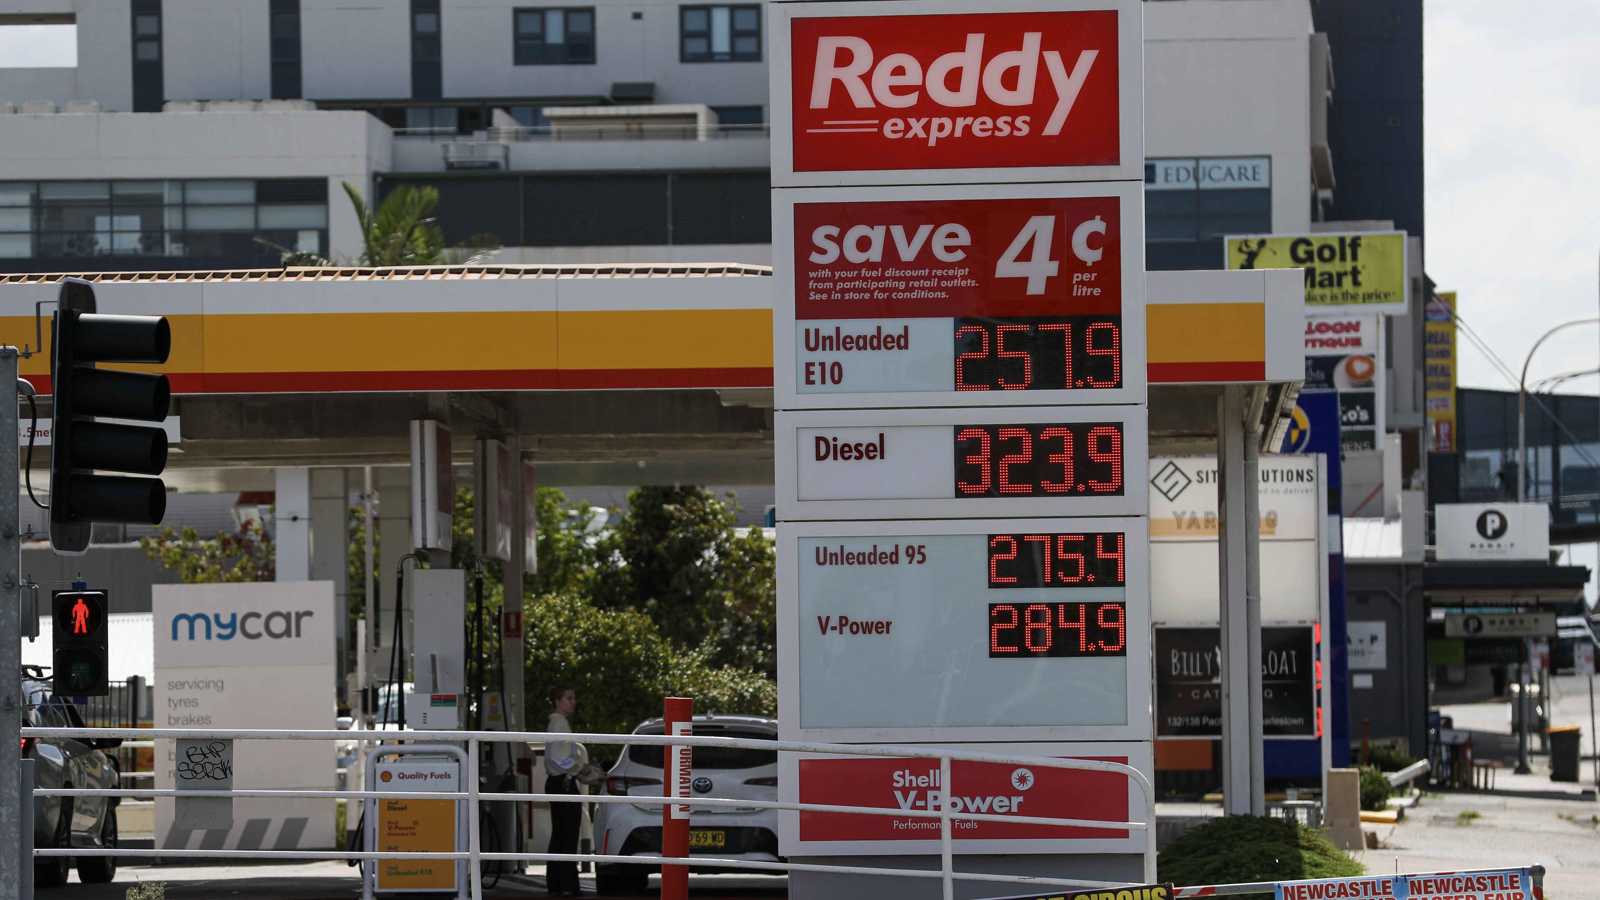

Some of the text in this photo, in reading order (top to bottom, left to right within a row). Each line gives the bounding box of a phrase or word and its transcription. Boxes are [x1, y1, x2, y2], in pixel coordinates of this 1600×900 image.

[809, 31, 1100, 136] Reddy
[882, 114, 1031, 147] express
[1163, 164, 1262, 184] EDUCARE
[809, 222, 972, 265] save
[994, 215, 1060, 296] 4
[1289, 235, 1362, 264] Golf
[808, 266, 969, 280] with your fuel discount receipt
[1073, 270, 1097, 286] per
[808, 277, 979, 291] from participating retail outlets.
[1072, 284, 1102, 296] litre
[808, 288, 949, 301] See in store for conditions.
[804, 325, 910, 351] Unleaded
[955, 322, 1121, 392] 257.9
[804, 361, 843, 385] E10
[814, 432, 886, 461] Diesel
[957, 425, 1122, 494] 323.9
[1196, 470, 1219, 484] SIT
[815, 544, 927, 566] Unleaded 95
[990, 534, 1124, 583] 275.4
[171, 609, 314, 641] mycar
[817, 615, 893, 635] V-Power
[990, 603, 1127, 653] 284.9
[1171, 648, 1297, 677] BILLY OAT
[168, 679, 224, 693] servicing
[168, 696, 199, 711] tyres
[168, 713, 212, 727] brakes
[398, 771, 451, 781] Quality Fuels
[892, 769, 941, 788] Shell
[893, 790, 1023, 813] V-Power
[893, 819, 978, 830] Performan Fuels
[1283, 880, 1392, 900] NEWCASTLE
[1410, 875, 1520, 895] NEWCASTLE
